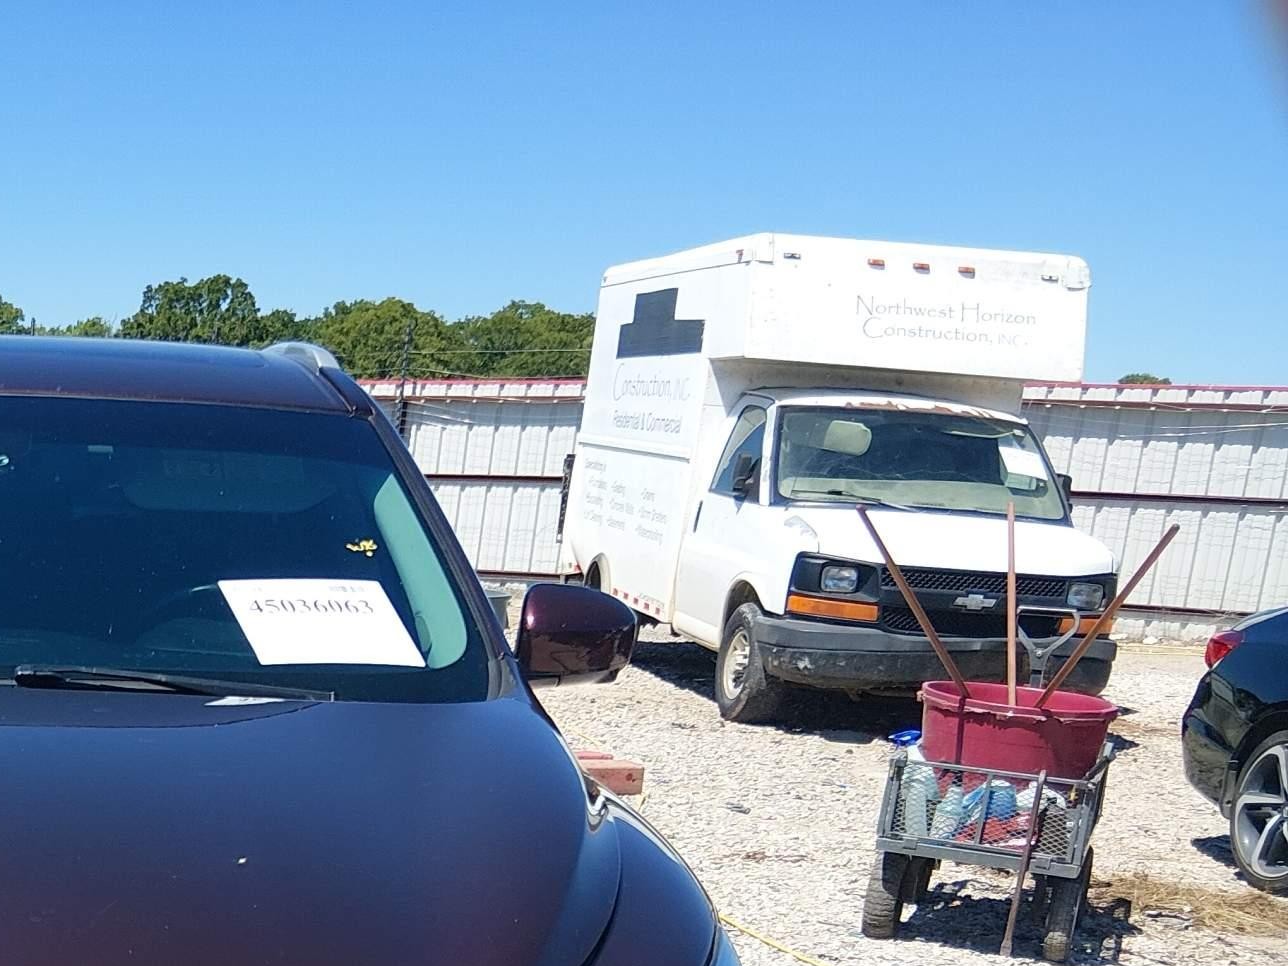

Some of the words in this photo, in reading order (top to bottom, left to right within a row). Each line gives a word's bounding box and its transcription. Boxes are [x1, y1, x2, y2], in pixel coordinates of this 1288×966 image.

[855, 294, 956, 320] Northwest
[960, 301, 1037, 325] Horizon
[862, 316, 993, 345] Construction,
[248, 599, 375, 615] 45036063
